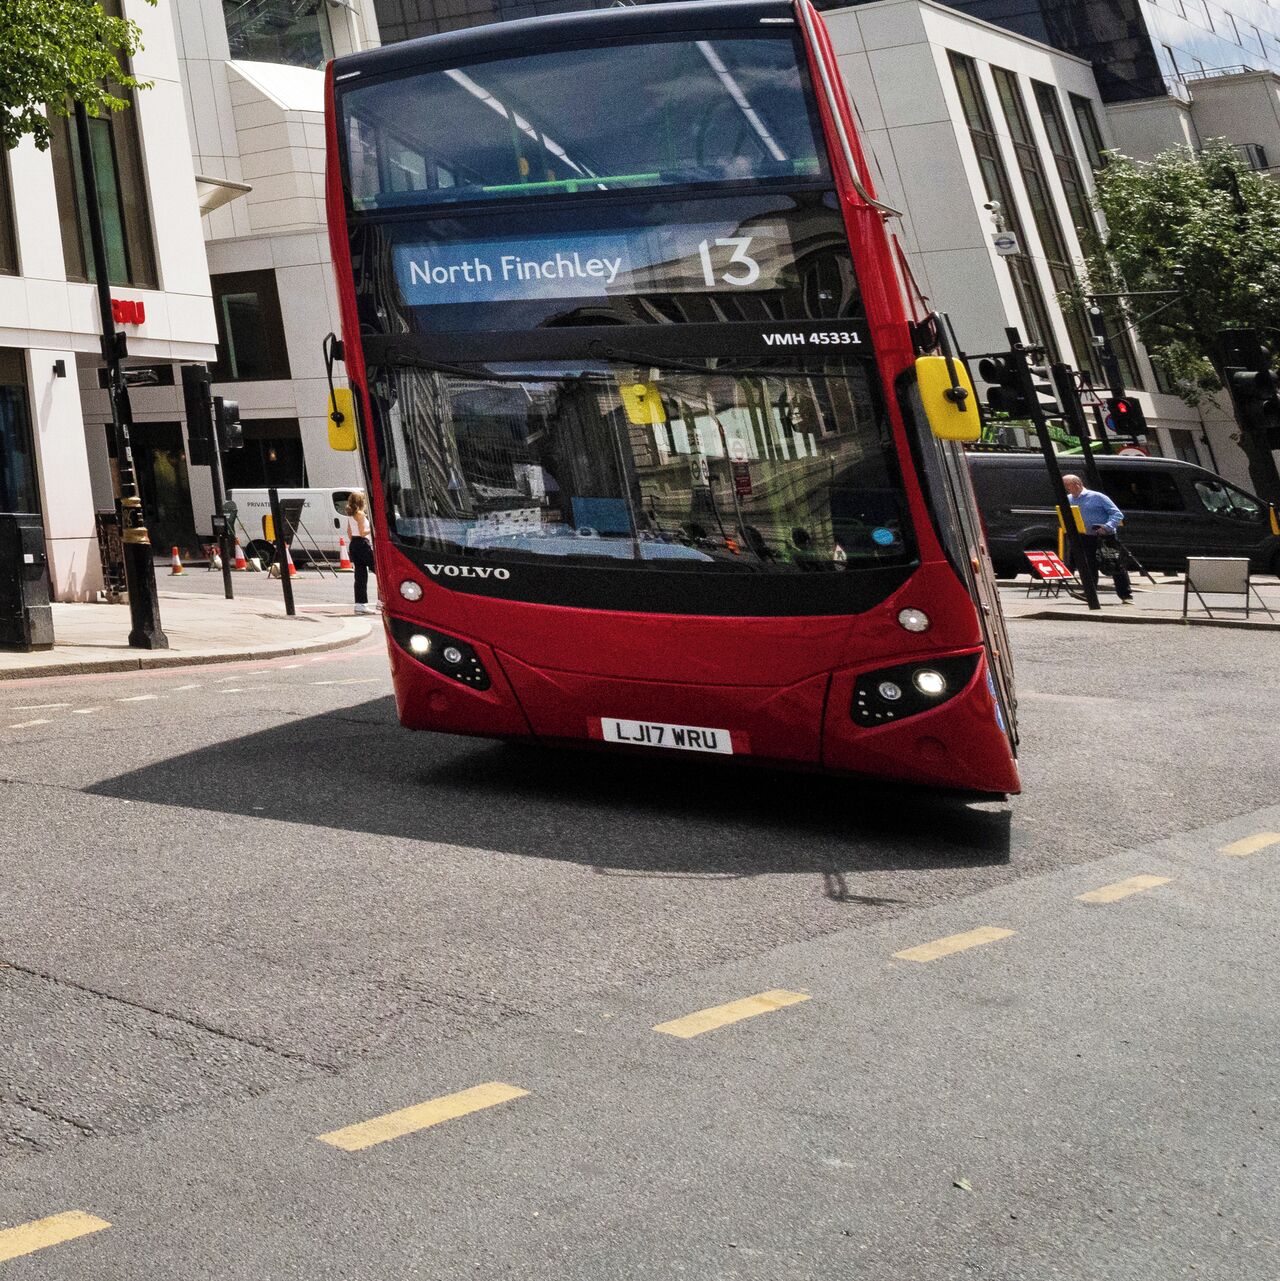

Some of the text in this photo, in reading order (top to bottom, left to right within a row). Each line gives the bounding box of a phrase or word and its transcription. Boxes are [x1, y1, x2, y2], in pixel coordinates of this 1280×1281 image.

[409, 236, 761, 287] North Finchley 13
[762, 331, 862, 346] VMH 45331
[423, 563, 510, 580] VOLVO
[615, 722, 718, 749] LJ17 WRU
